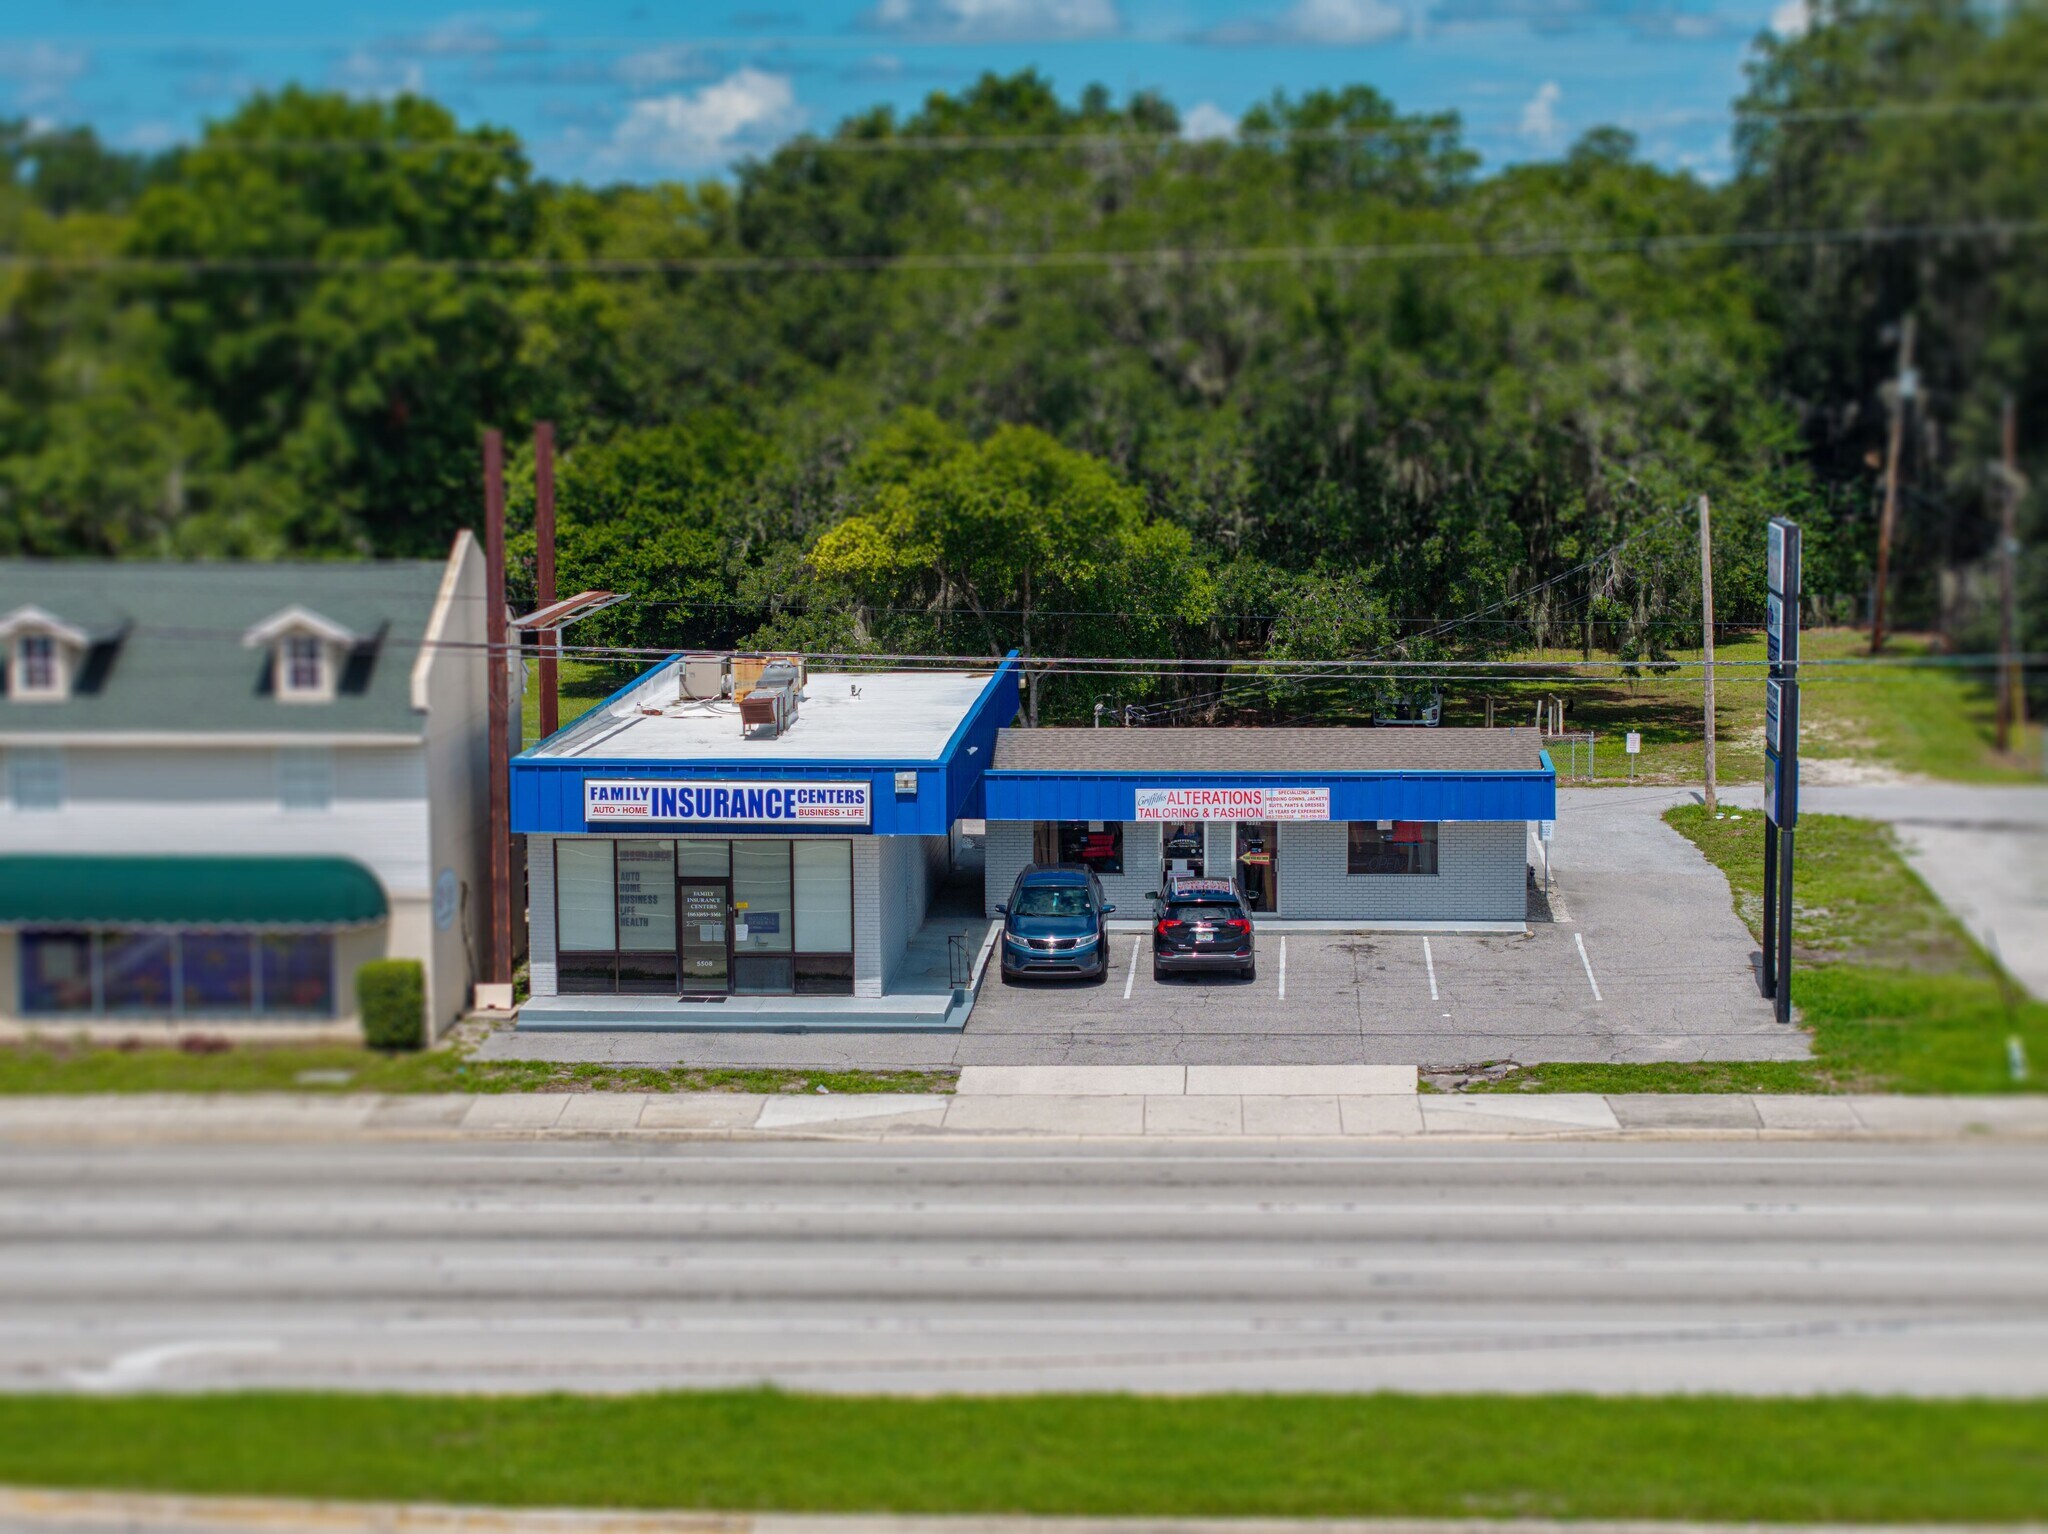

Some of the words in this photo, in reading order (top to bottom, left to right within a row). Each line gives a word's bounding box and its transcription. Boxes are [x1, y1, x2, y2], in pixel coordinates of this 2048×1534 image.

[1167, 791, 1262, 805] ALTERATIONS
[590, 787, 650, 801] FAMILY
[651, 787, 797, 819] INSURANCE
[797, 789, 865, 804] CENTERS
[593, 806, 616, 814] AUTO
[622, 806, 648, 814] HOME
[798, 808, 840, 816] BUSINESS
[846, 808, 864, 817] LIFE
[1138, 807, 1199, 818] TAILORING
[1202, 808, 1210, 818] &
[1213, 807, 1263, 818] FASHION
[620, 872, 640, 881] AUTO
[620, 884, 641, 892] HOME
[620, 895, 658, 904] BUSINESS
[620, 906, 635, 916] LIFE
[620, 918, 648, 927] HEALTH
